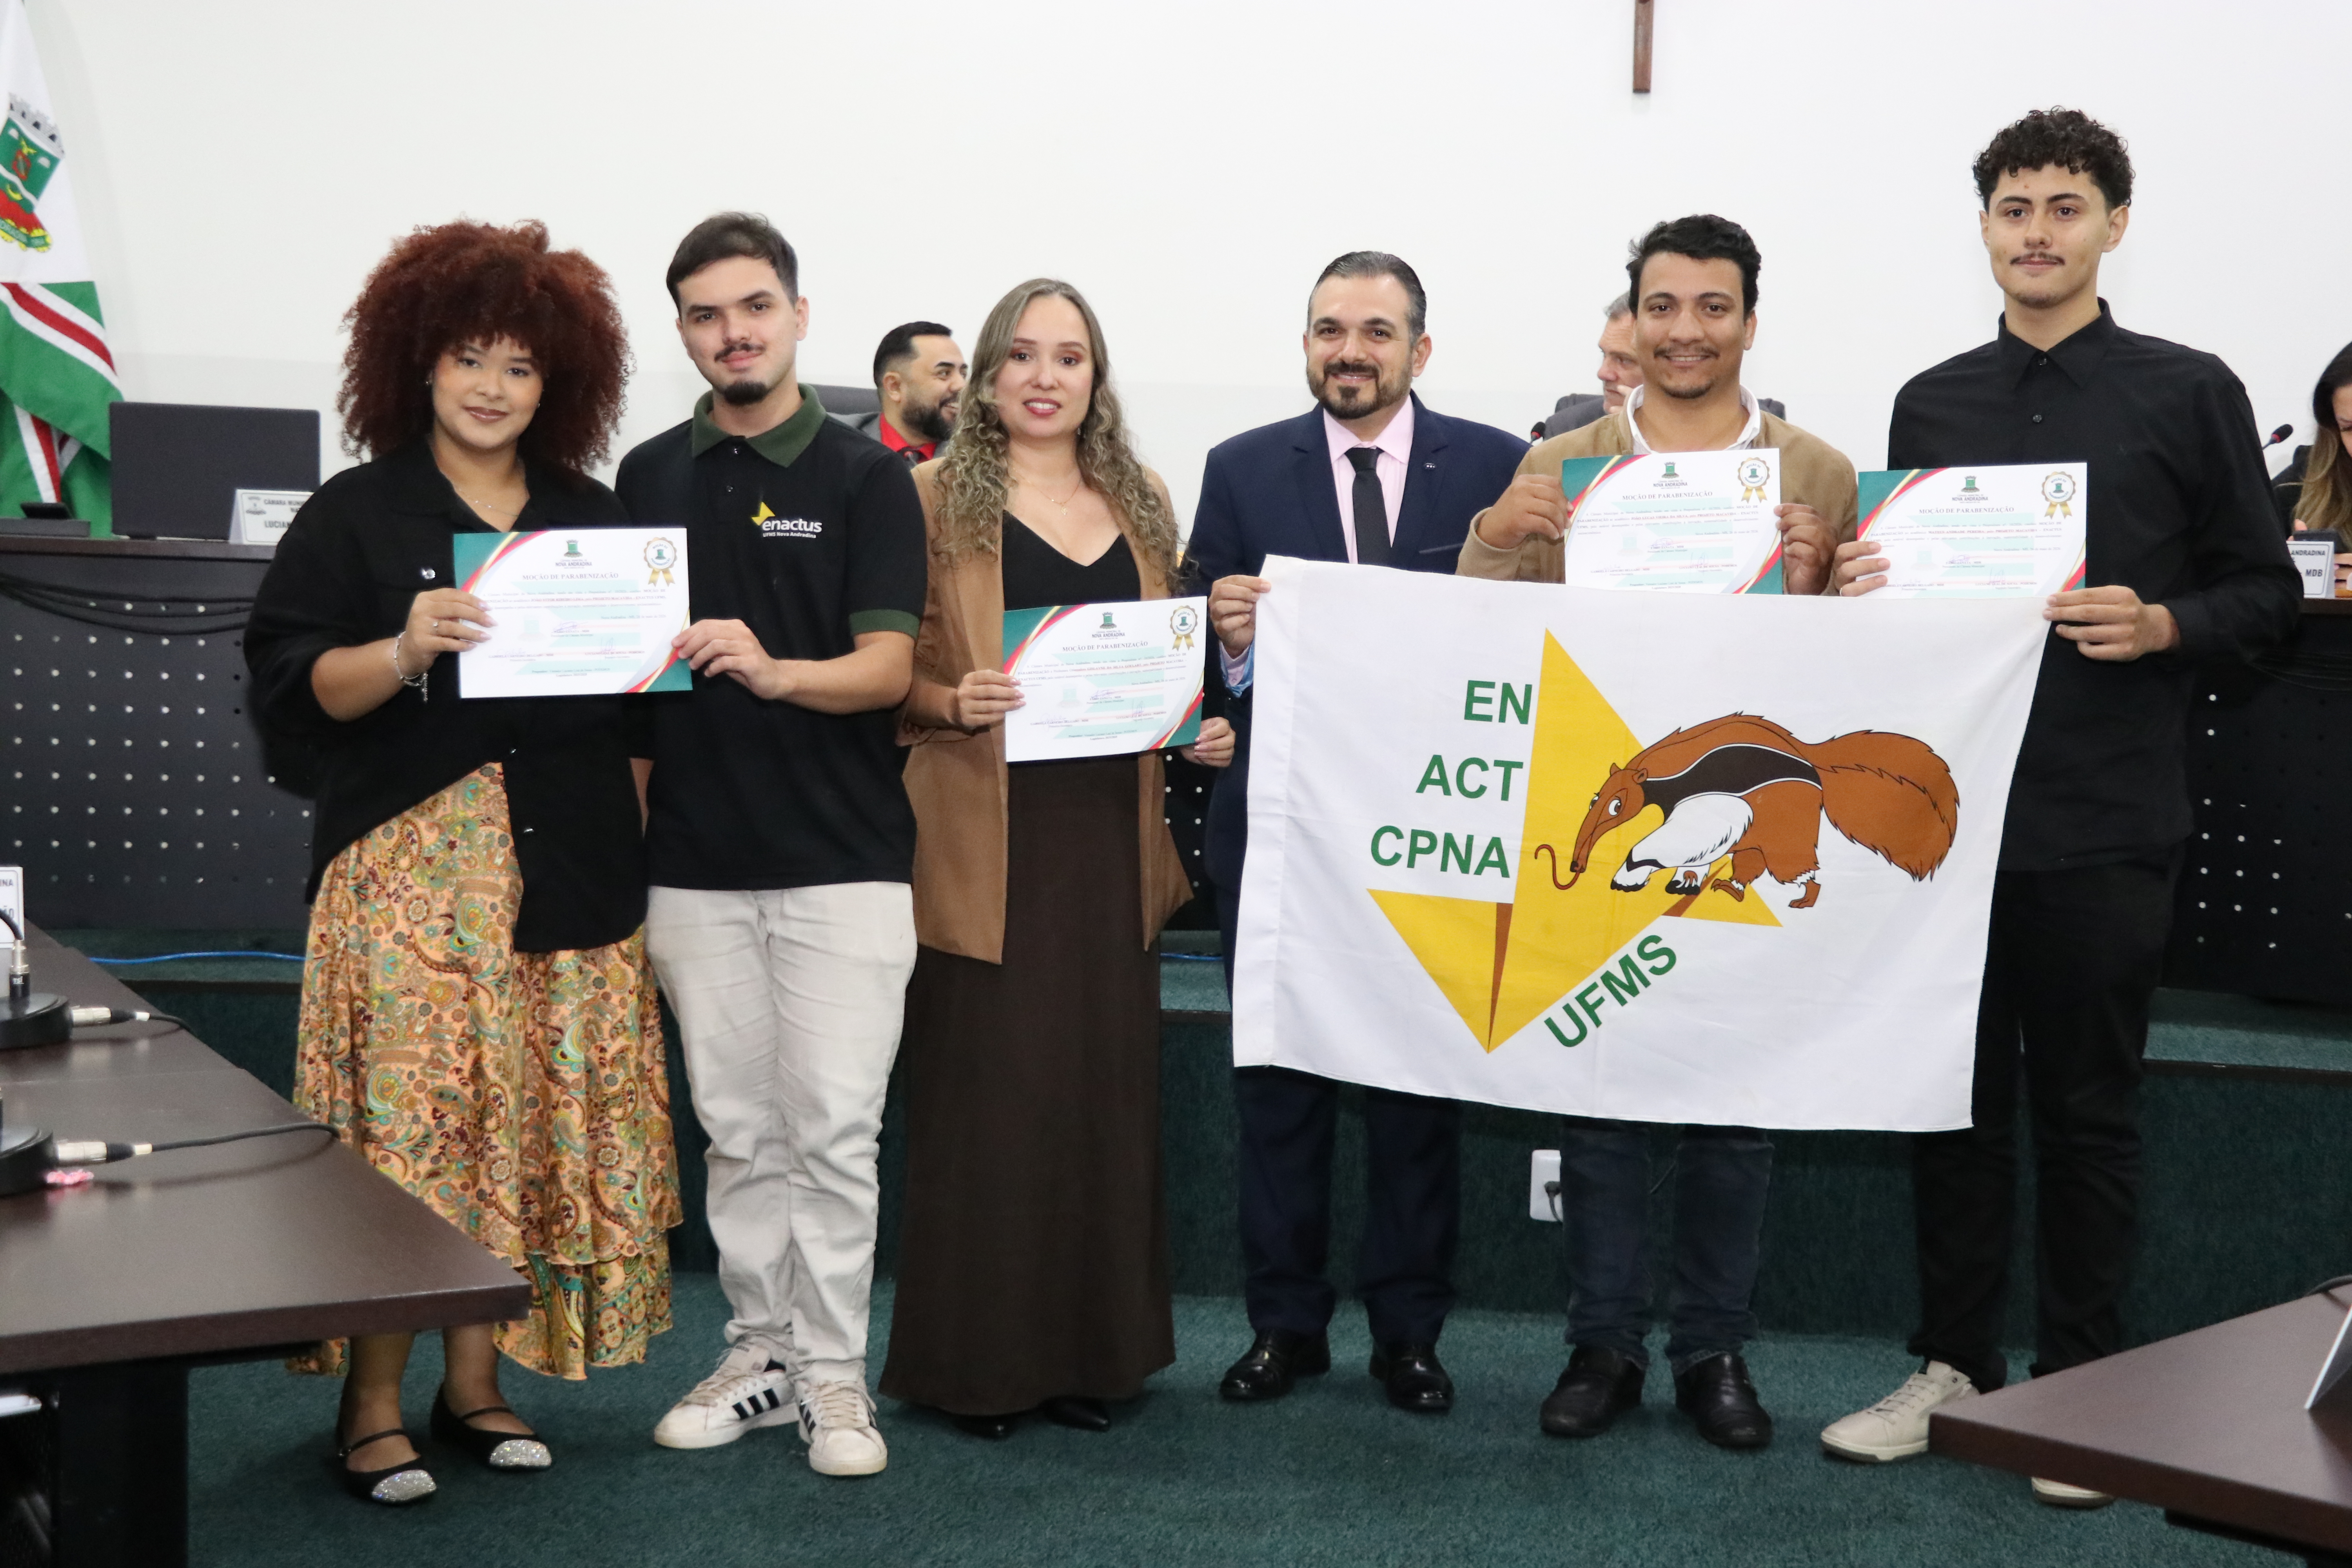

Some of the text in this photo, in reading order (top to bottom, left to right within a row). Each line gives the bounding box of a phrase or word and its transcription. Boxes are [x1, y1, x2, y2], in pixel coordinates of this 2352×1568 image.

[1658, 490, 1713, 499] PARABENIZAÇÃO
[762, 518, 822, 533] enactus
[1097, 641, 1148, 650] PARABENIZAÇÃO
[1464, 680, 1532, 725] EN
[1416, 755, 1523, 801] ACT
[1371, 825, 1510, 878] CPNA
[1544, 935, 1677, 1047] UFMS
